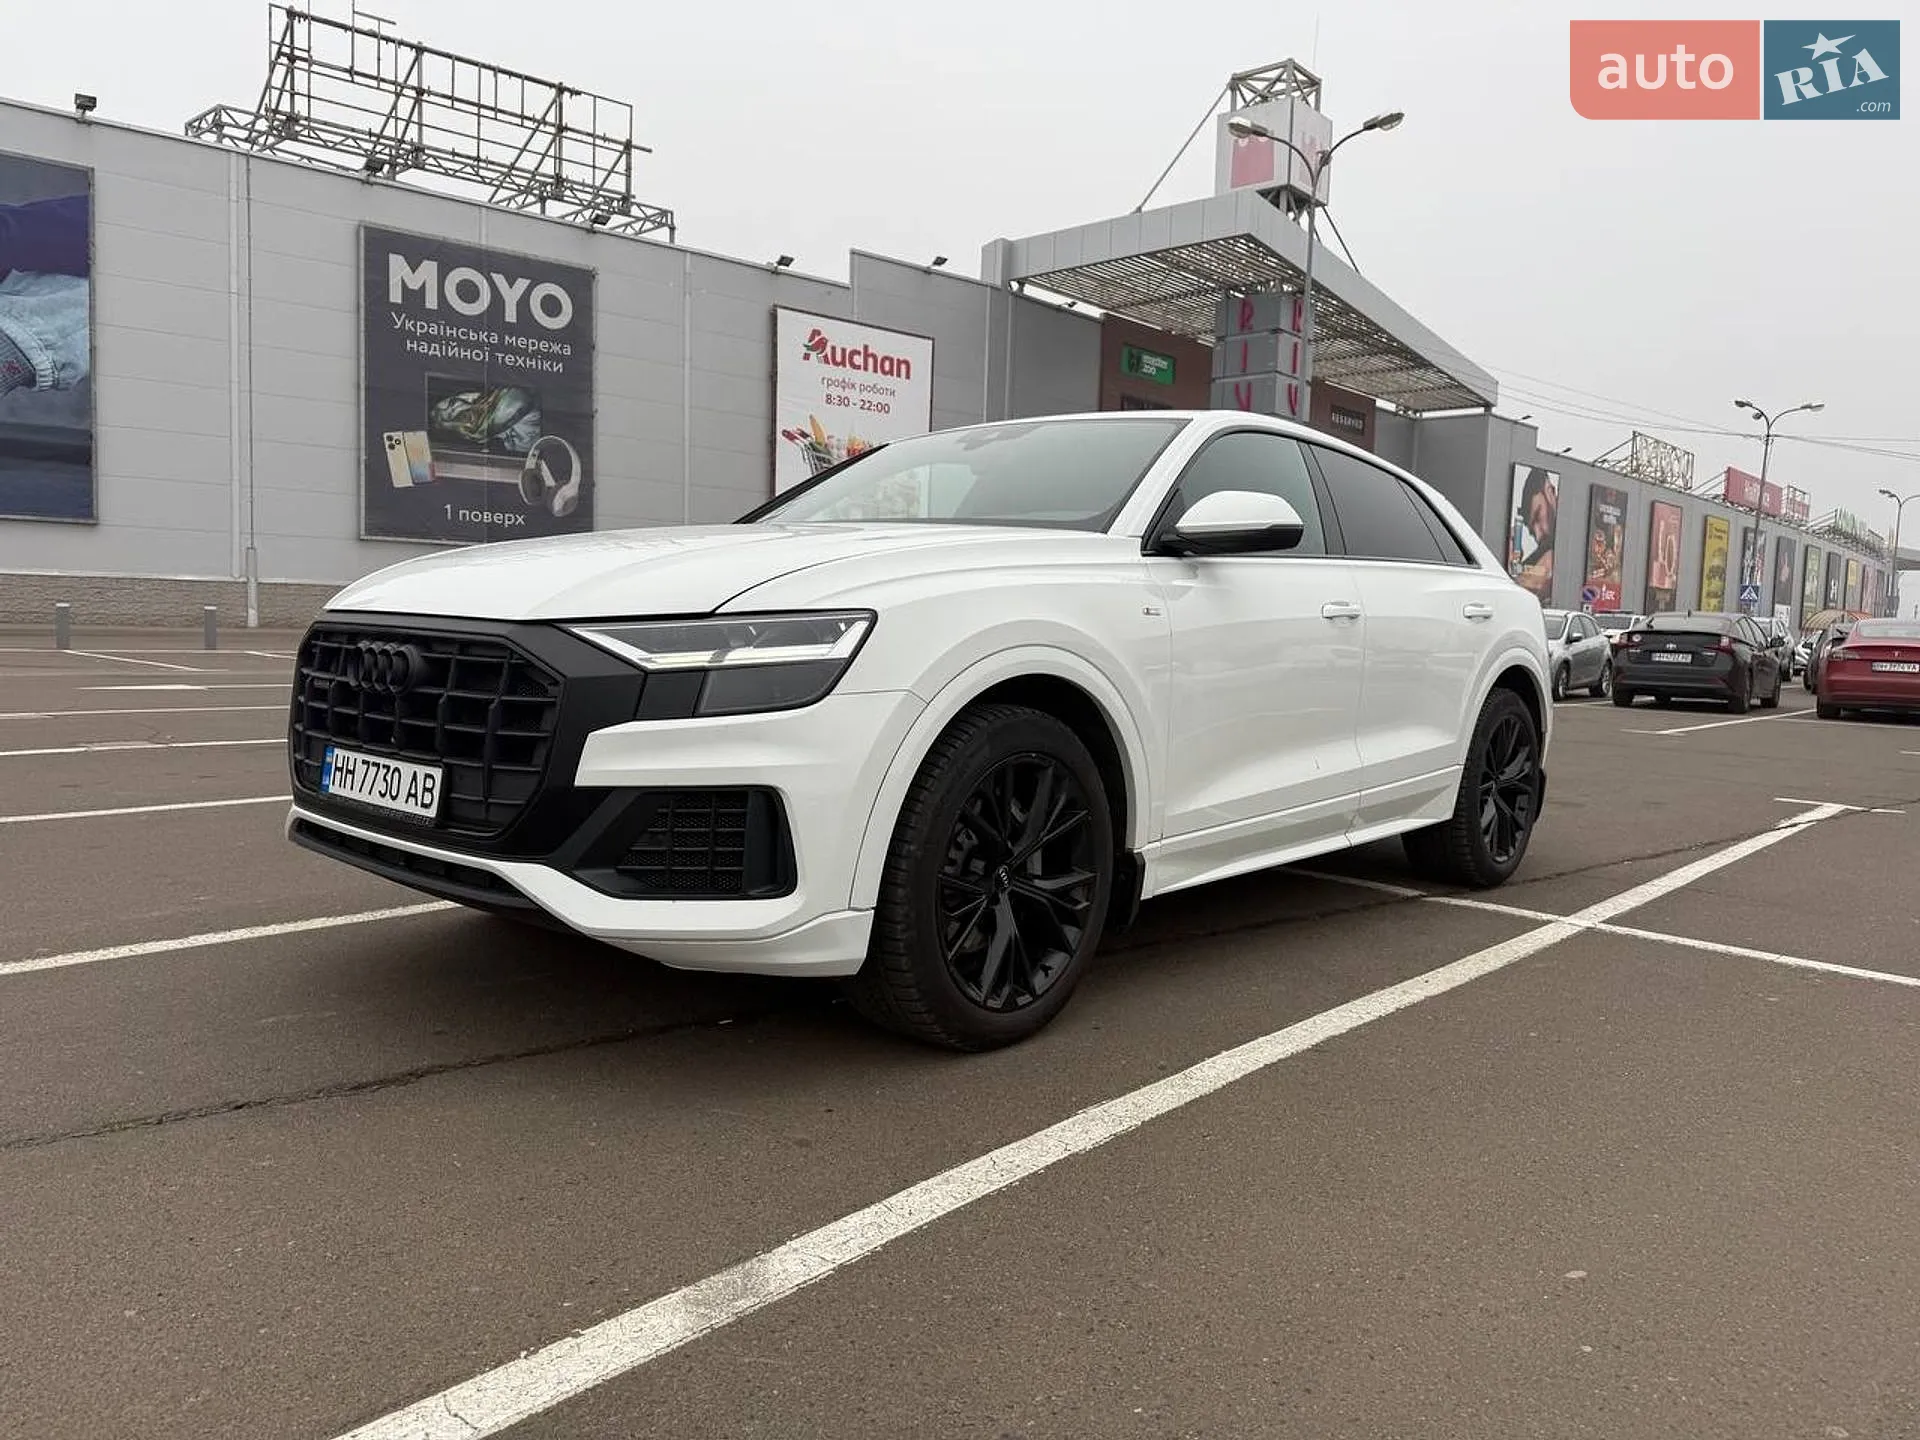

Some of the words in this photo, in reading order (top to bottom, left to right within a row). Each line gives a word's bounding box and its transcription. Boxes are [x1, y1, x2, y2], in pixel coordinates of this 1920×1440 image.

[388, 252, 573, 330] MOYO
[390, 311, 498, 344] Українська
[504, 335, 572, 356] мережа
[406, 338, 490, 362] надійної
[495, 352, 564, 374] техніки
[802, 328, 911, 380] Auchan
[821, 375, 856, 392] графік
[859, 382, 896, 398] роботи
[825, 393, 850, 407] 8:30
[859, 399, 890, 415] 22:00
[445, 503, 453, 521] 1
[459, 508, 526, 527] поверх
[332, 754, 357, 791] HH
[359, 759, 401, 800] 7730
[405, 770, 435, 808] AB
